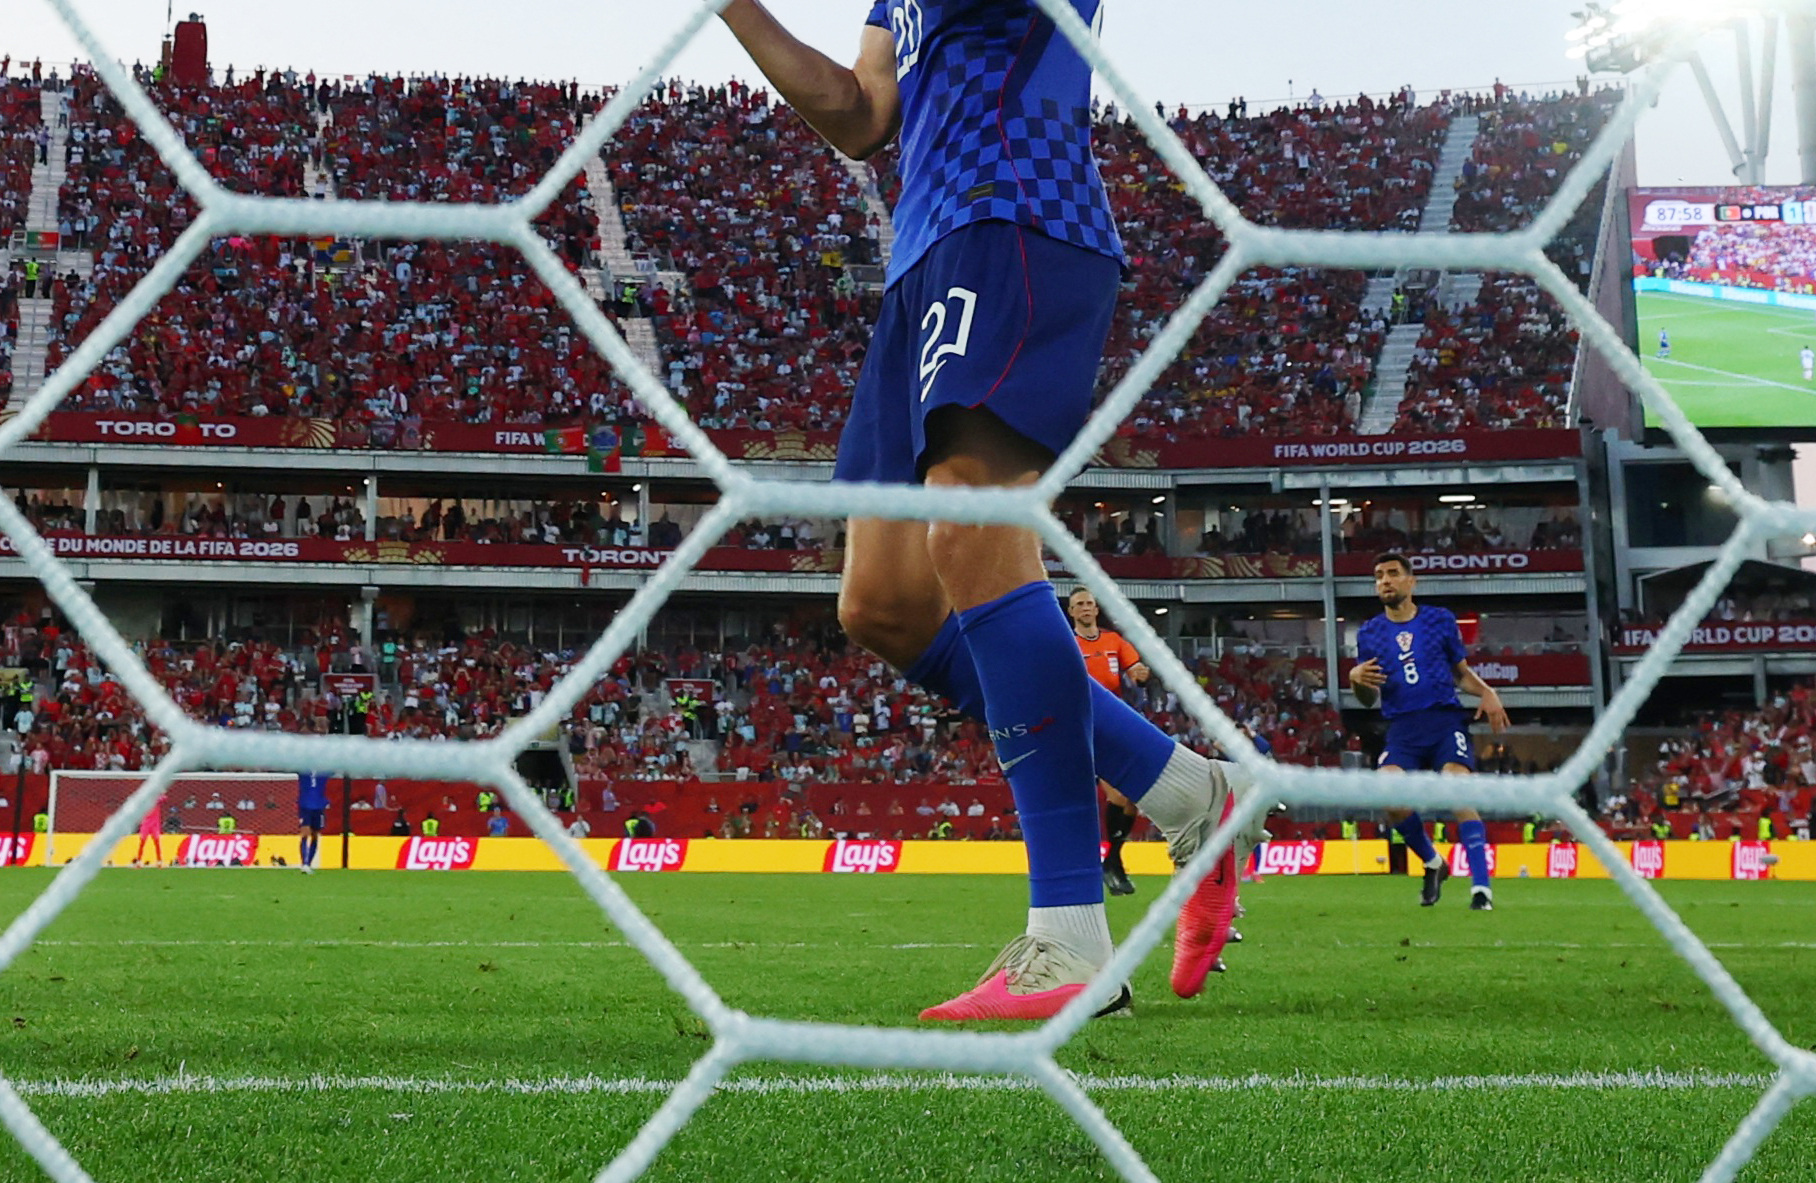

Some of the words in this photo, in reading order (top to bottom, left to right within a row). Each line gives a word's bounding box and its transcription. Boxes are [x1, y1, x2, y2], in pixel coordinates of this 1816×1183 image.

[1657, 207, 1703, 221] 87:58
[95, 420, 237, 438] TOROTO
[495, 431, 532, 446] FIFA
[1274, 444, 1309, 458] FIFA
[1311, 442, 1370, 458] WORLD
[1372, 441, 1405, 456] CUP
[1407, 439, 1467, 455] 2026
[58, 537, 84, 552] DU
[85, 538, 147, 553] MONDE
[149, 540, 173, 554] DE
[174, 540, 196, 555] LA
[199, 541, 237, 556] FIFA
[239, 542, 299, 557] 2026
[562, 549, 676, 564] TORONT
[1409, 553, 1529, 570] ORONTO
[1624, 629, 1655, 647] IFA
[1681, 627, 1731, 646] RLD
[1733, 626, 1775, 644] CUP
[1403, 663, 1419, 684] 8
[1454, 731, 1467, 752] 8
[186, 834, 250, 868] Lay's
[406, 836, 470, 870] Lay's
[617, 838, 680, 871] Lay's
[831, 840, 895, 873] Lay's
[1257, 841, 1317, 875] Lay's
[1453, 843, 1494, 876] L's
[1550, 843, 1576, 878] Lay's
[1632, 841, 1663, 878] Lay's
